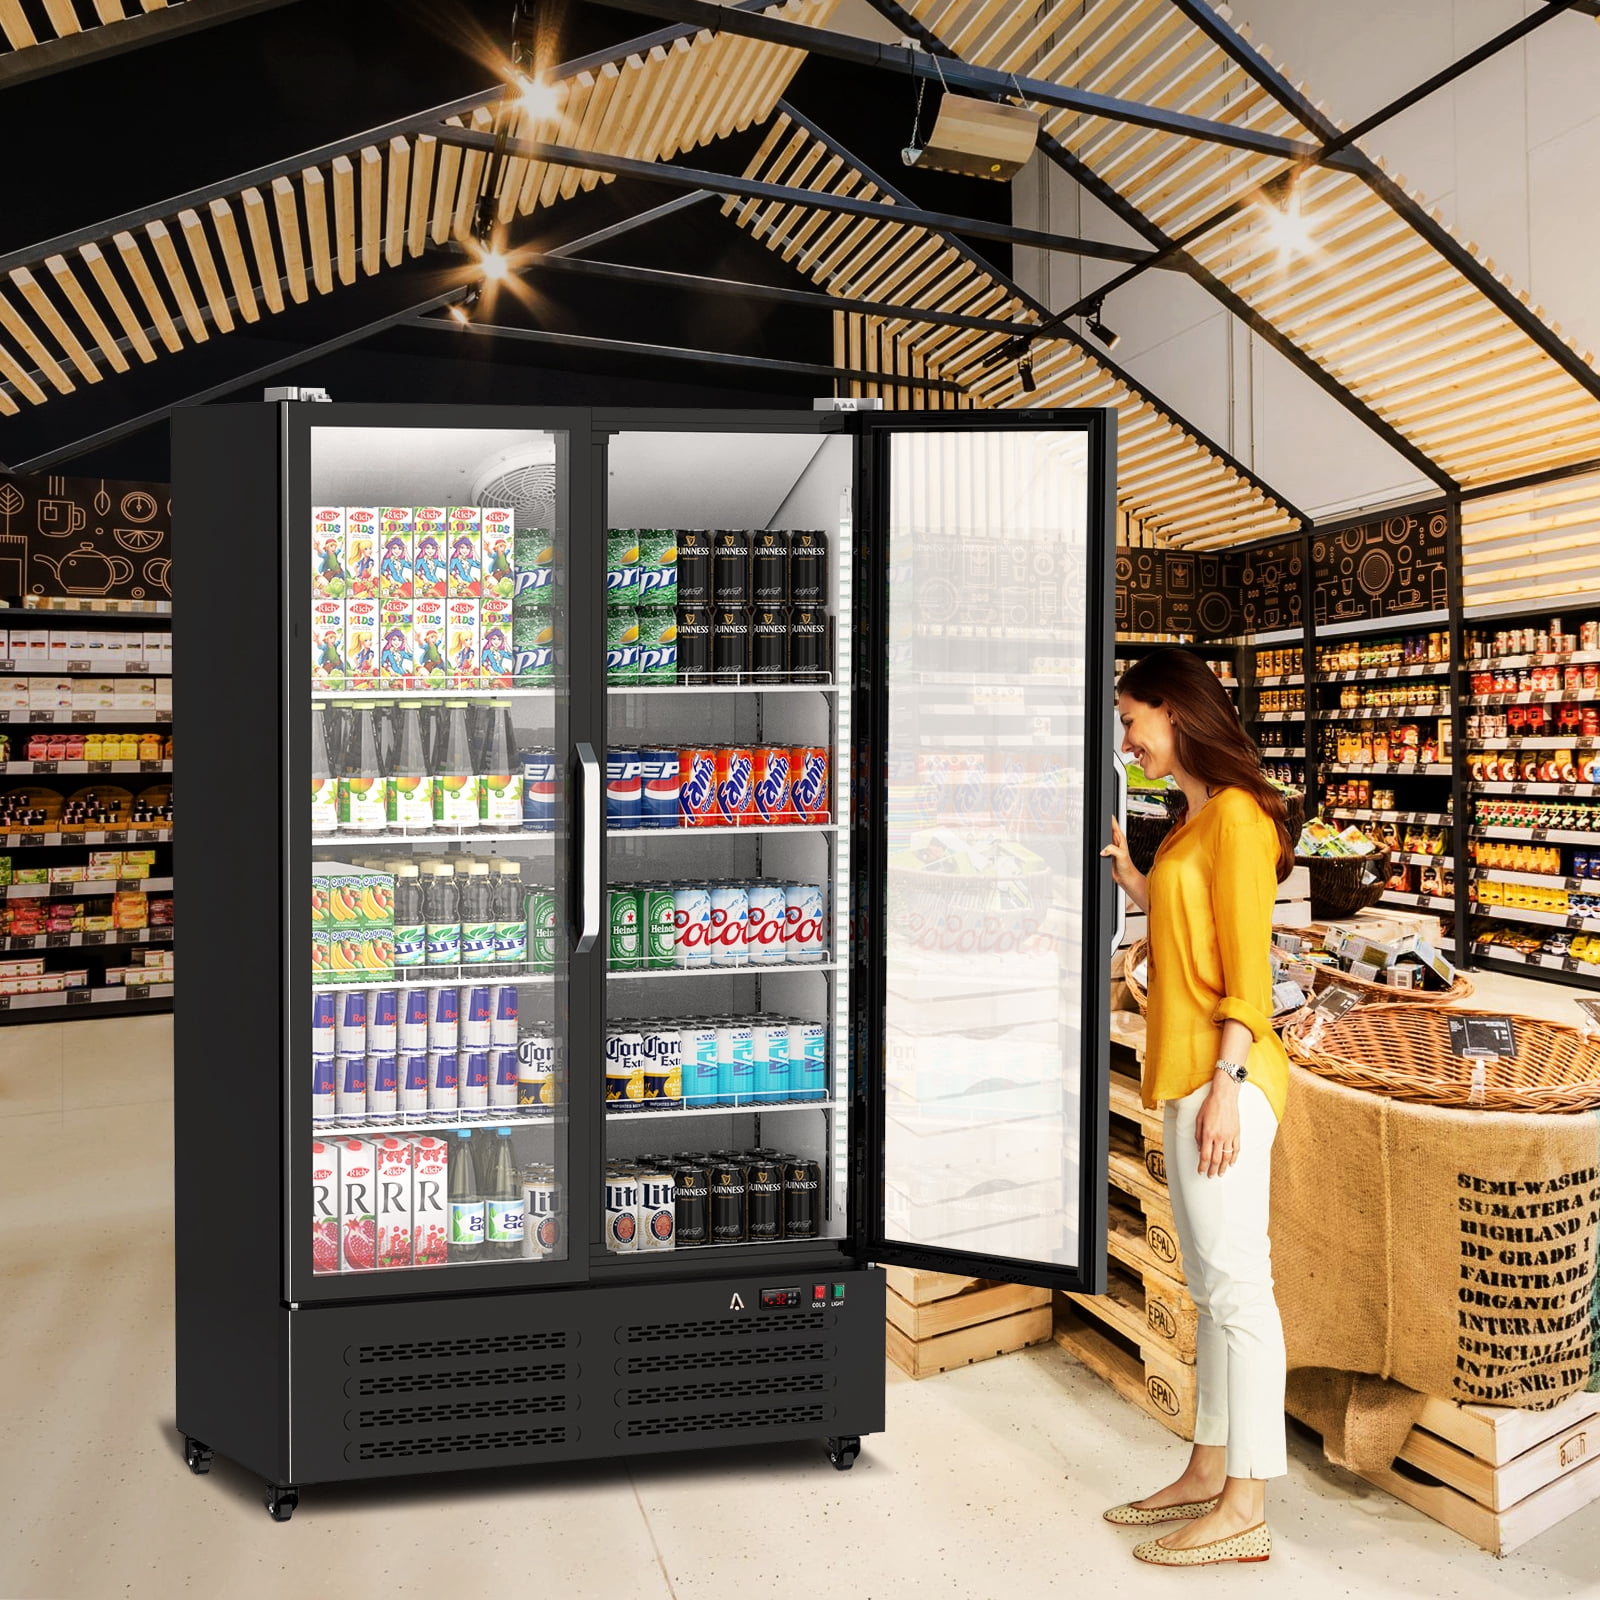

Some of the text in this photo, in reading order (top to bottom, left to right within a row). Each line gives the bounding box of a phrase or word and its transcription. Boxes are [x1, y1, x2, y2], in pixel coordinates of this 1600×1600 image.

[679, 758, 714, 824] Fanta
[717, 758, 752, 824] Fanta
[754, 756, 789, 822] Fanta
[791, 756, 826, 822] Fanta
[345, 1183, 371, 1215] R
[381, 1182, 407, 1213] R
[418, 1180, 444, 1212] R
[1458, 1194, 1584, 1219] SUMATERA
[1151, 1230, 1172, 1260] EPAL
[1460, 1218, 1580, 1243] HIGHLAND
[1460, 1241, 1493, 1260] DP
[1499, 1243, 1576, 1266] GRADE
[1460, 1260, 1588, 1289] FAIRTRADE
[1458, 1287, 1565, 1310] ORGANIC
[1148, 1304, 1170, 1335] EPAL
[1151, 1383, 1175, 1412] EPAL
